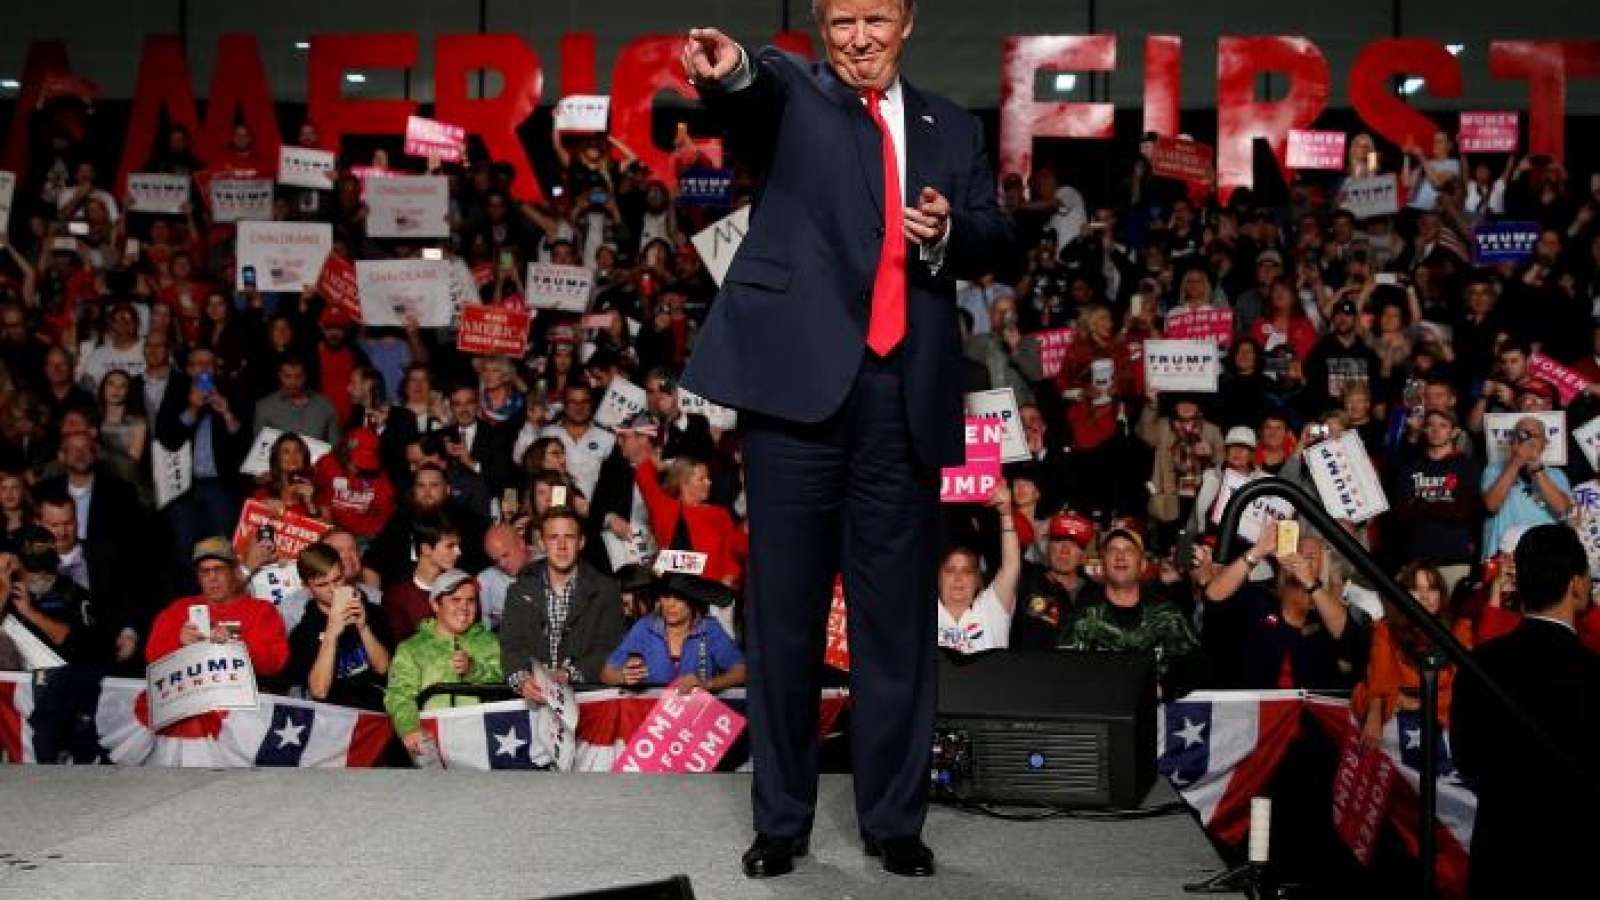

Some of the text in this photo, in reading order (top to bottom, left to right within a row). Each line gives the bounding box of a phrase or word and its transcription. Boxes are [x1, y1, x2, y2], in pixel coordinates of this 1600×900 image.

[1000, 35, 1600, 206] FIRST
[1464, 138, 1514, 149] TRUMP
[131, 181, 186, 191] TRUMP
[215, 193, 270, 201] TRUMP
[1476, 234, 1538, 245] TRUMP
[533, 275, 588, 289] TRUMP
[1168, 310, 1232, 326] WOMEN
[1149, 355, 1212, 364] TRUMP
[1320, 449, 1357, 517] TRUMP
[153, 657, 246, 692] TRUMP
[161, 672, 239, 699] PENCE
[661, 728, 695, 768] FOR
